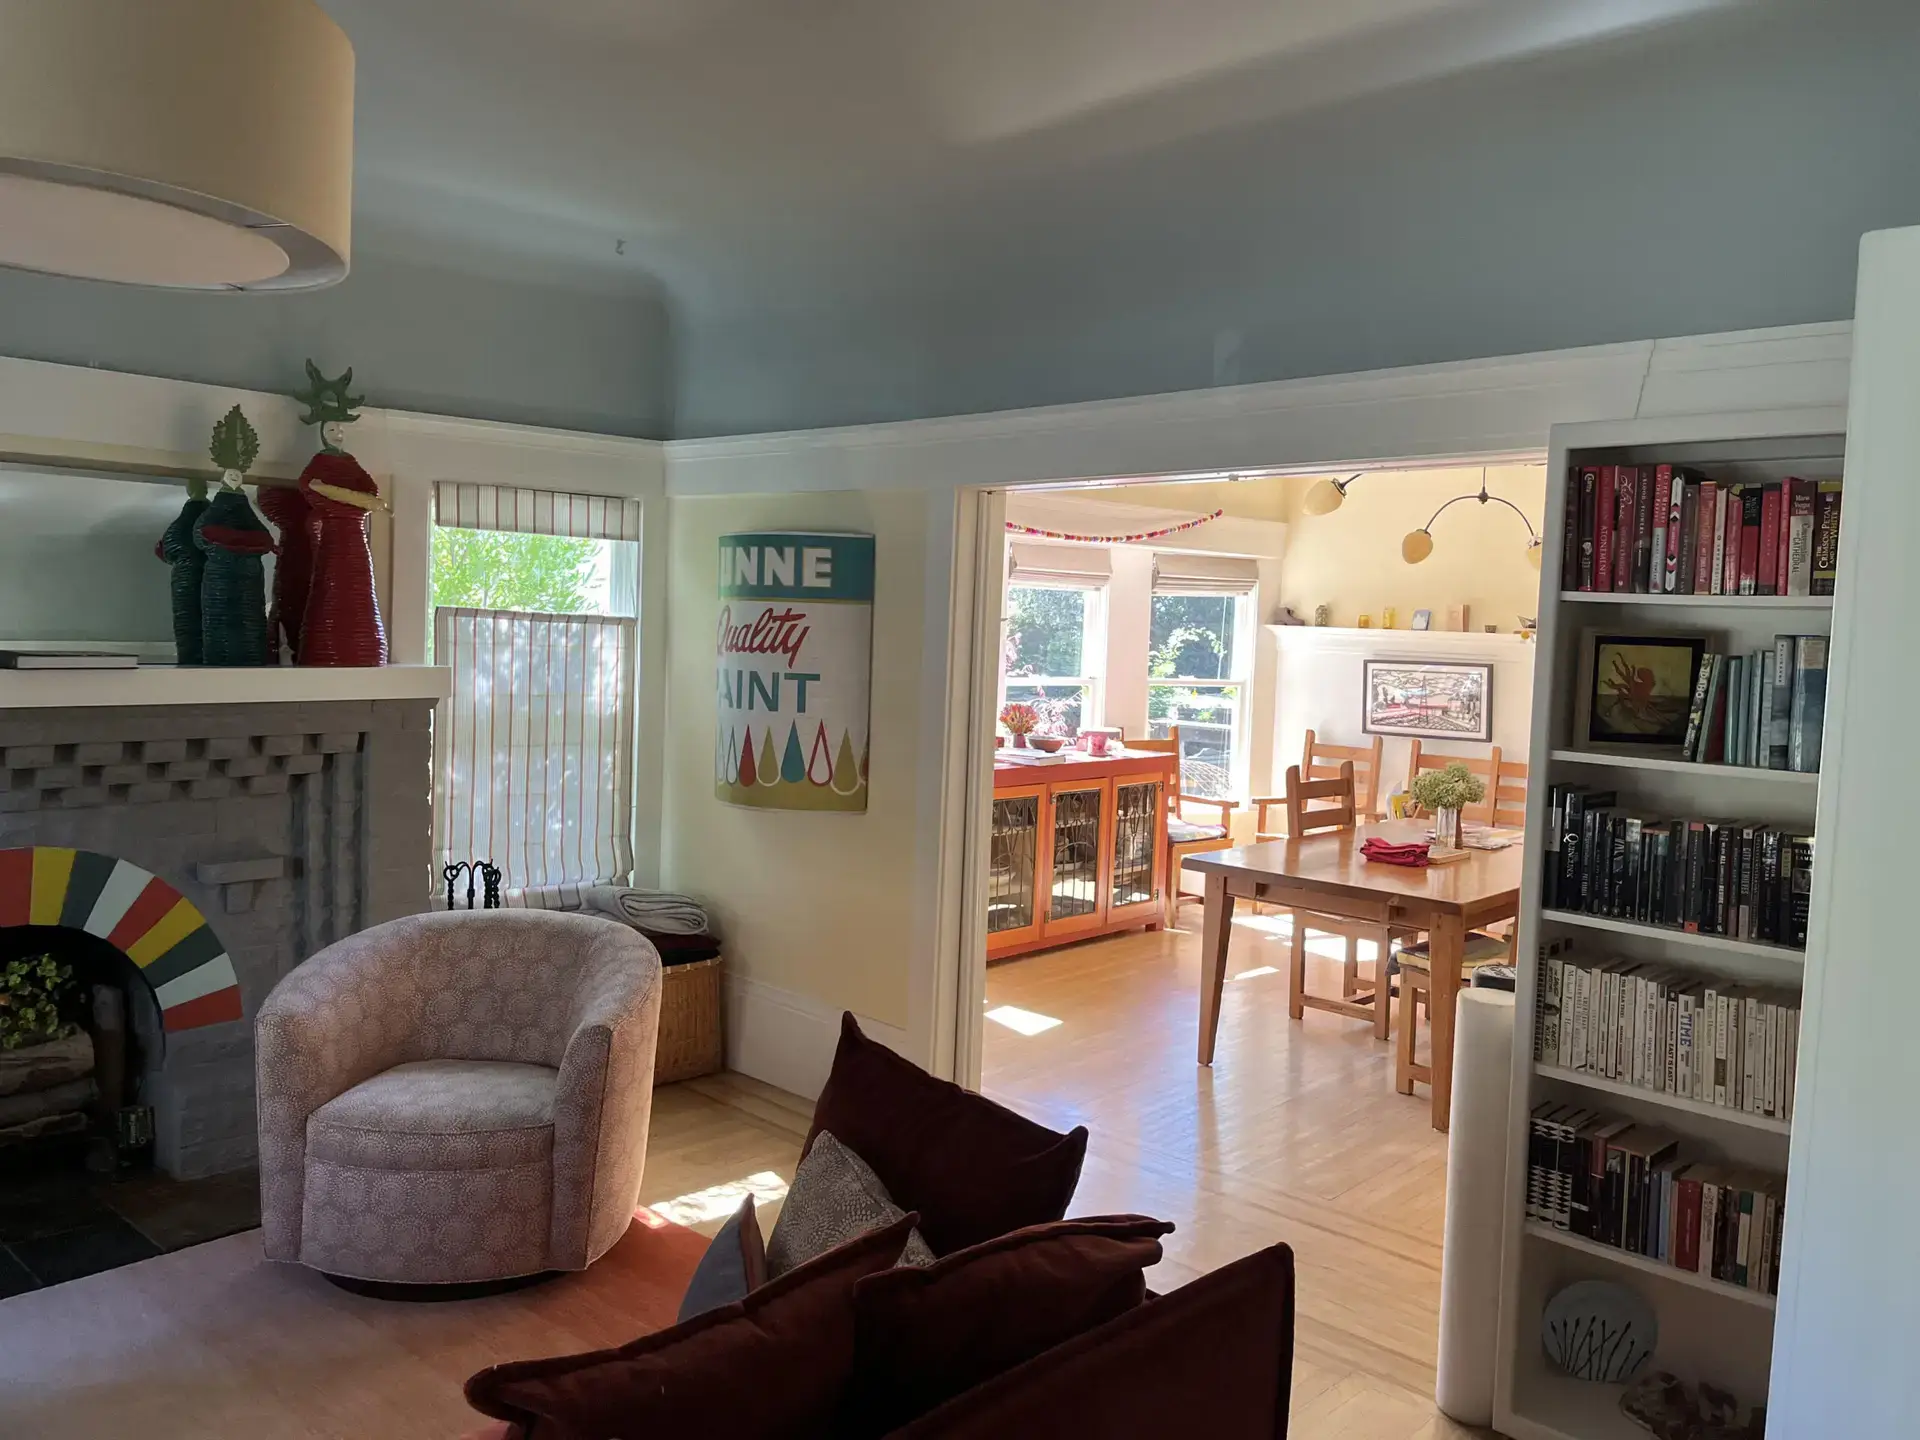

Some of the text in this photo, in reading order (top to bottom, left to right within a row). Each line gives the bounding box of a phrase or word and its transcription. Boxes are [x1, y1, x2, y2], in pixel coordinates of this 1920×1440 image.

[1821, 505, 1831, 529] PETAL
[1830, 511, 1838, 538] WHITE
[1599, 525, 1609, 576] ATONEMENT
[1792, 537, 1801, 574] CATHEDRAL
[1819, 530, 1829, 568] CRIMSON
[717, 605, 811, 669] Quality
[717, 668, 821, 714] AINT
[1563, 833, 1579, 878] QUINCUNX
[1742, 847, 1751, 860] CITY
[1741, 871, 1750, 894] THIEVES
[1680, 1013, 1693, 1048] TIME
